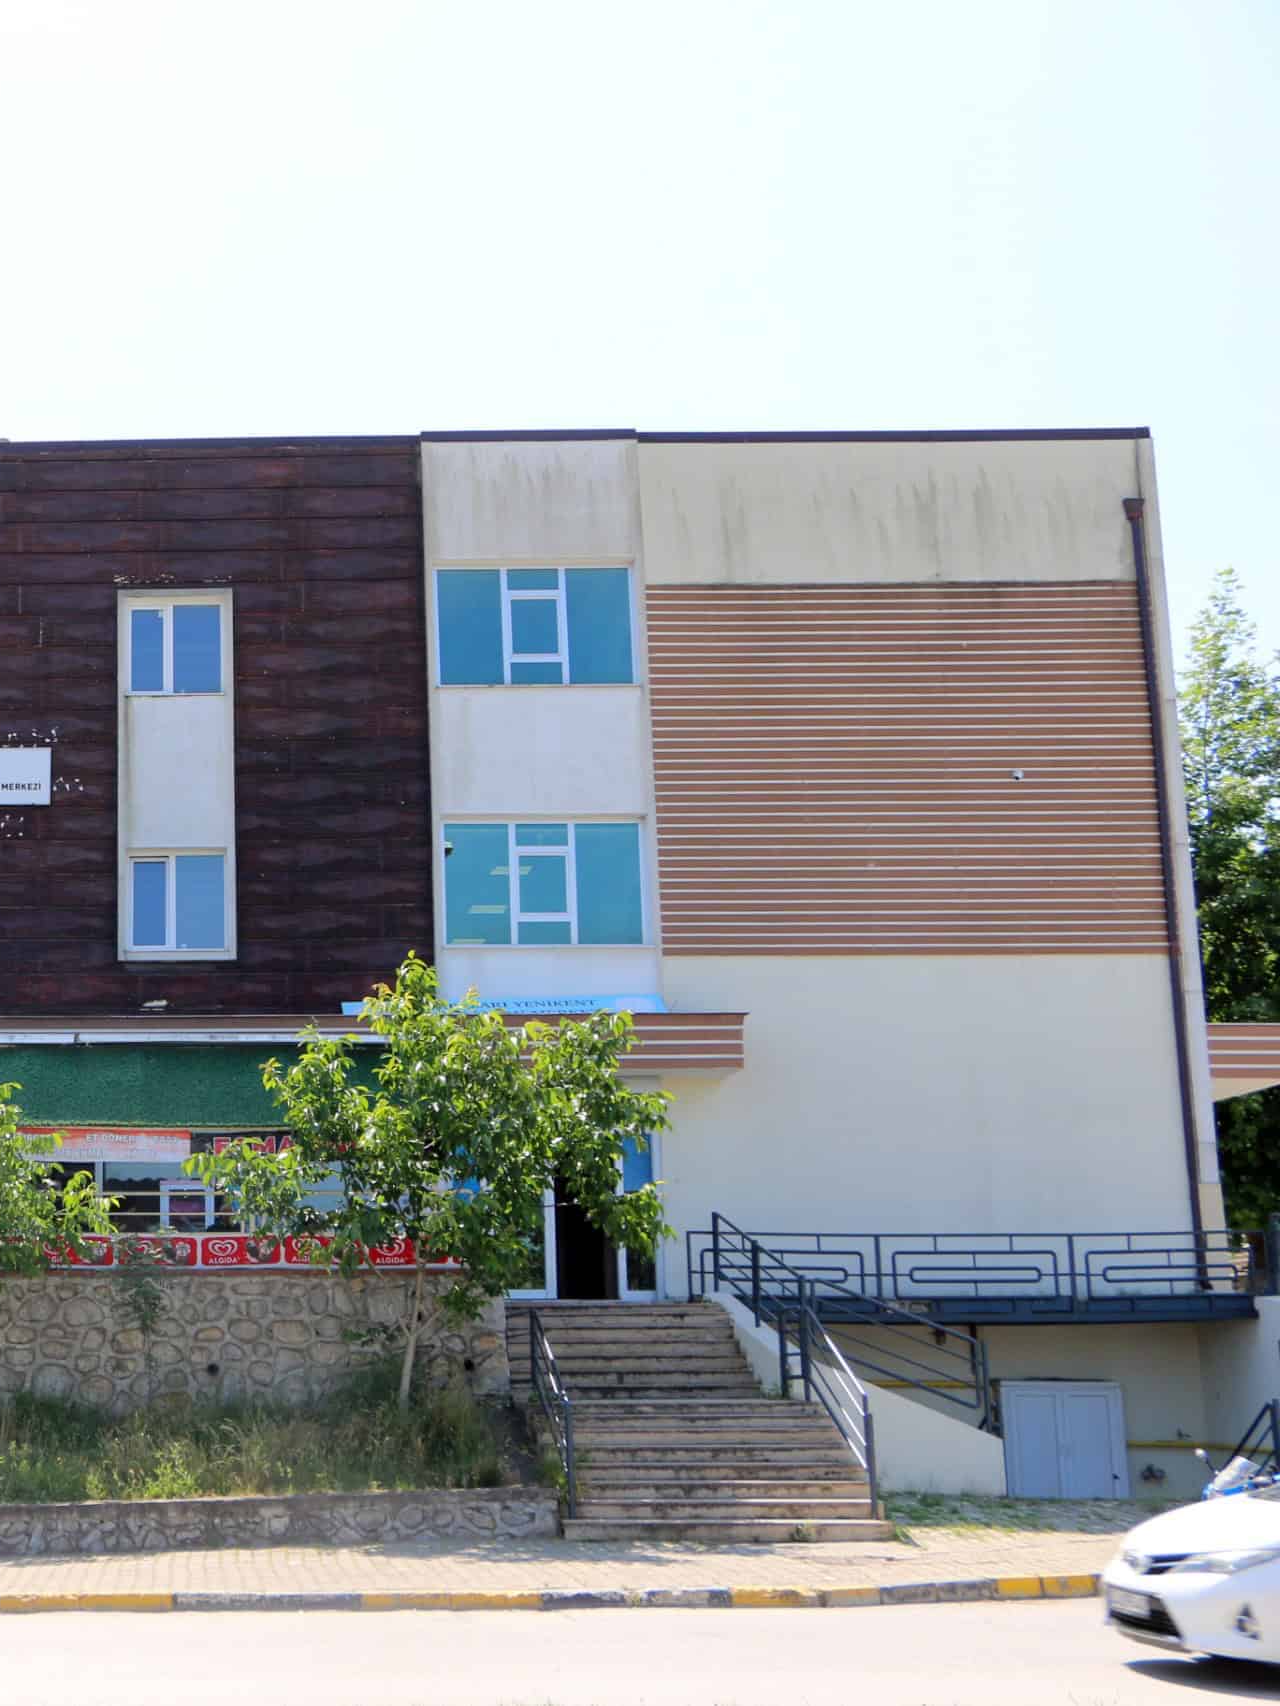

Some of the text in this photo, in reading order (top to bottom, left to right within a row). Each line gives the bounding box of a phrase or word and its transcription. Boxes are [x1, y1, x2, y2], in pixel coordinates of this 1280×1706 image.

[1, 781, 42, 791] MERKEZİ
[208, 1256, 238, 1265] ALGIDA
[376, 1256, 405, 1264] ALGIDA
